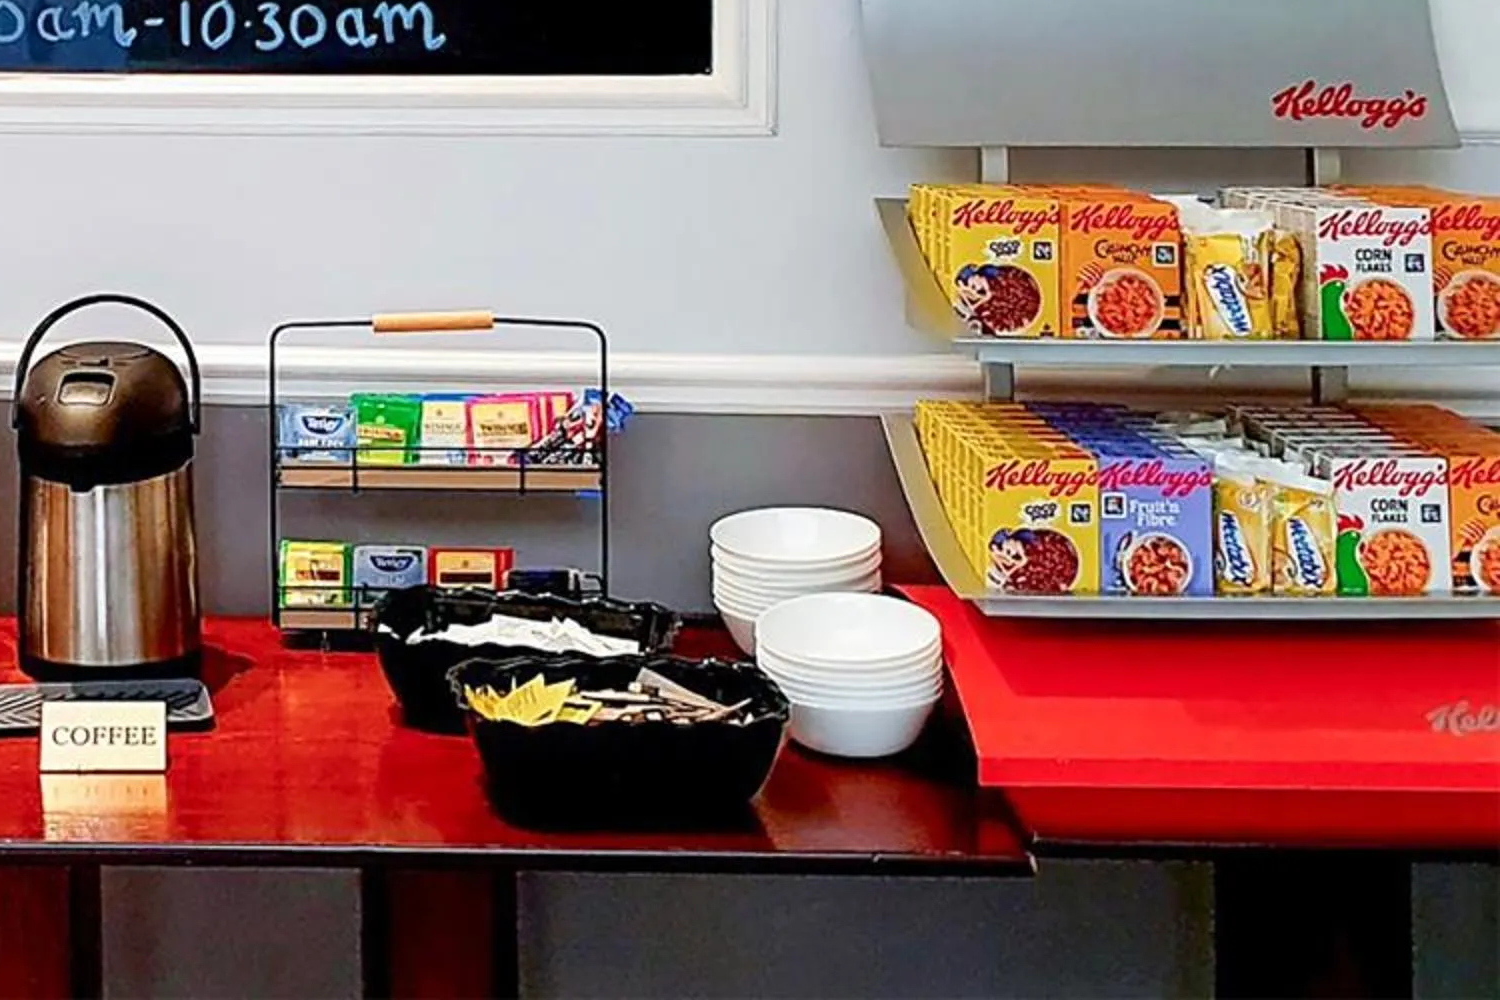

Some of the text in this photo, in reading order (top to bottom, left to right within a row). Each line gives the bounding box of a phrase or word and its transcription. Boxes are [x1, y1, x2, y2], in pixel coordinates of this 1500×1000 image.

[1272, 79, 1427, 128] Kellogg's
[953, 199, 1061, 234] Kellogg's
[1071, 203, 1181, 239] Kellogg's
[1318, 209, 1431, 246] Kellogg's
[1355, 249, 1392, 262] CORN
[985, 459, 1100, 496] Kellogg's
[1100, 459, 1212, 497] Kellogg's
[1334, 458, 1449, 496] Kellogg's
[1370, 498, 1409, 512] CORN
[52, 725, 157, 747] COFFEE
